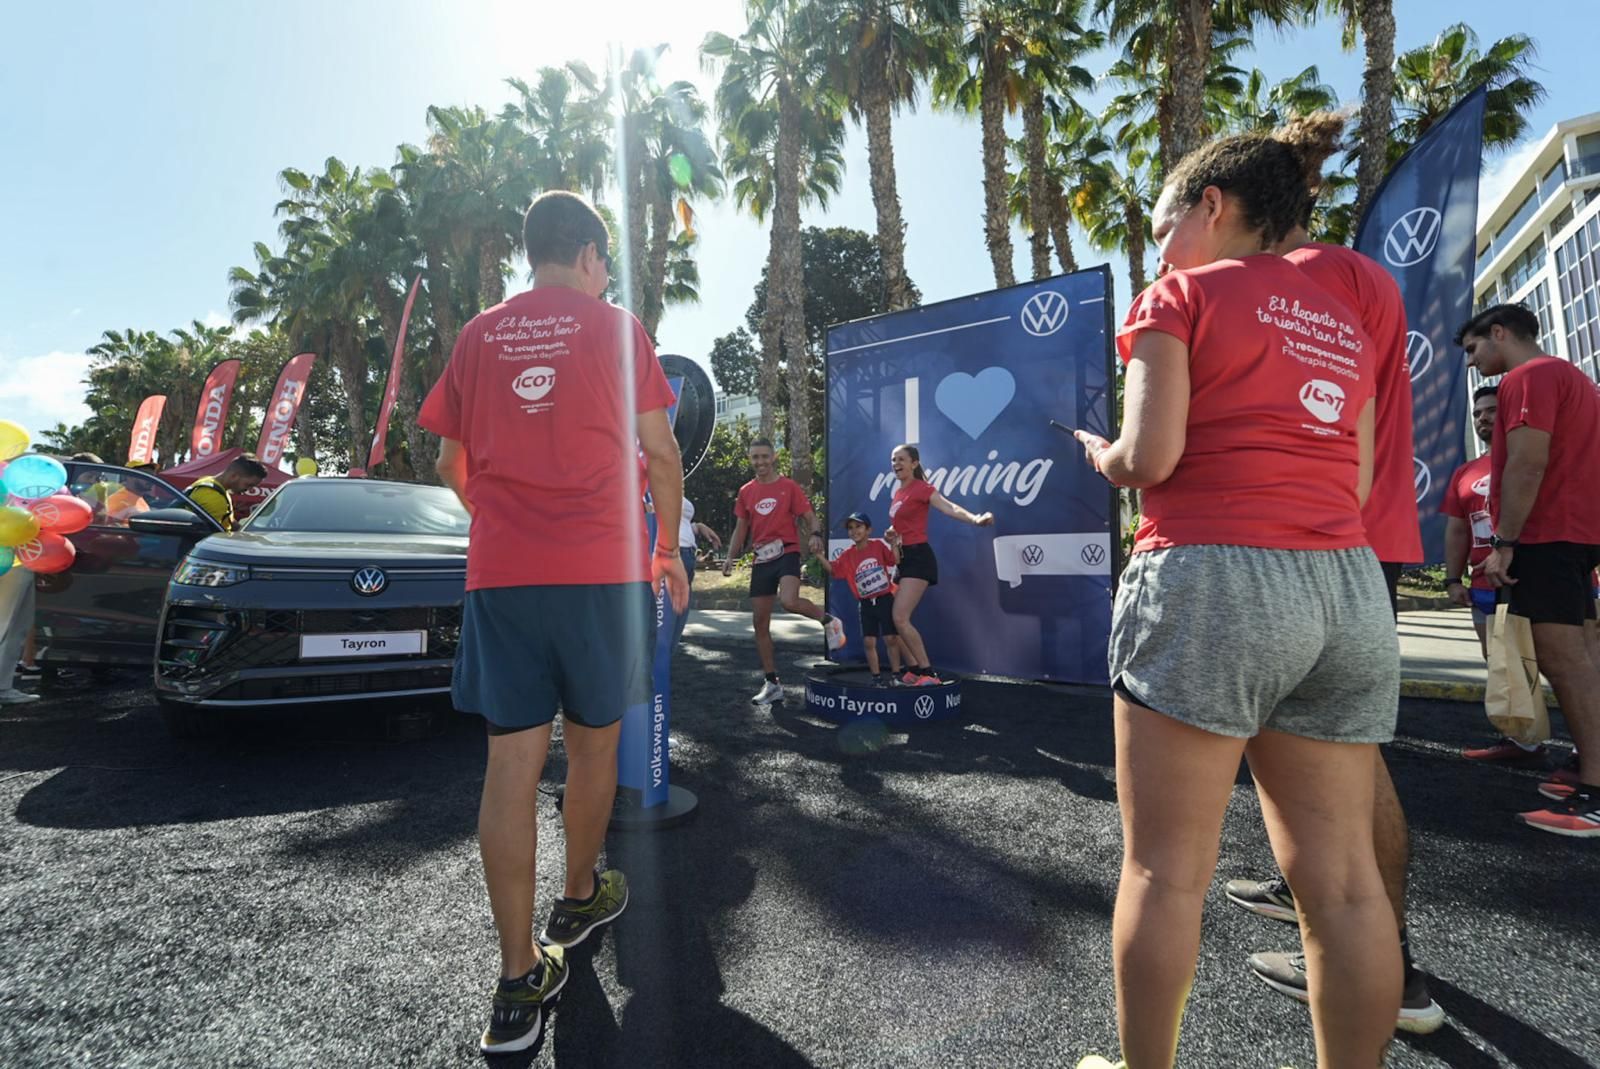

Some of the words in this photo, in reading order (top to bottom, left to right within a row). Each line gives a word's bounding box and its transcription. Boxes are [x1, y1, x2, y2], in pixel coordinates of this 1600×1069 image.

[558, 315, 576, 324] no
[1256, 307, 1272, 324] te
[1274, 315, 1312, 337] sienta
[1312, 325, 1336, 344] tan
[484, 331, 495, 343] te
[496, 330, 530, 342] sienta
[532, 327, 552, 340] tan
[502, 344, 513, 353] Te
[515, 341, 567, 353] recuperamos.
[1296, 340, 1359, 368] recuperamos.
[514, 373, 556, 390] ICOT
[1302, 383, 1345, 412] ICOT
[904, 376, 920, 444] I
[869, 450, 1054, 506] rnning
[756, 501, 777, 509] ICOT
[340, 639, 386, 651] Tayron
[838, 695, 897, 715] Tayron
